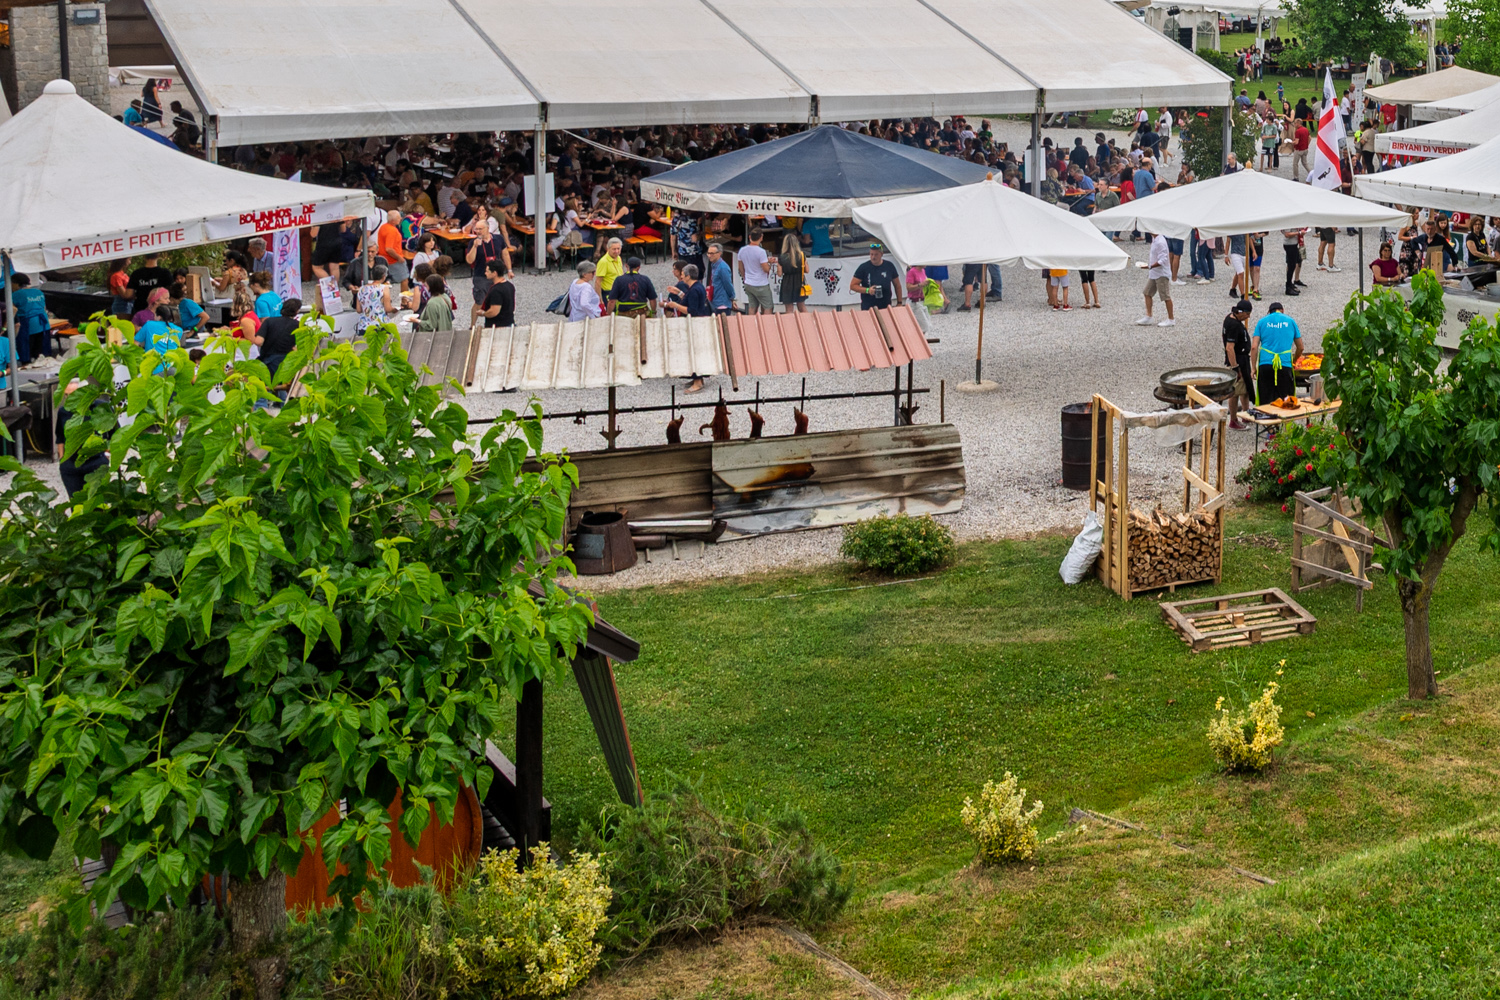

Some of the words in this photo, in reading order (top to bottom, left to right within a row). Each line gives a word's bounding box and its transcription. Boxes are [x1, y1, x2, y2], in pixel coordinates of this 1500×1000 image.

[1392, 141, 1422, 152] BIRYANI
[1423, 145, 1431, 153] DI
[239, 208, 292, 225] BOLINHOS
[302, 203, 316, 214] DE
[736, 199, 780, 212] Hirter
[784, 200, 815, 213] Bier
[61, 238, 124, 261] PATATE
[129, 228, 185, 249] FRITTE
